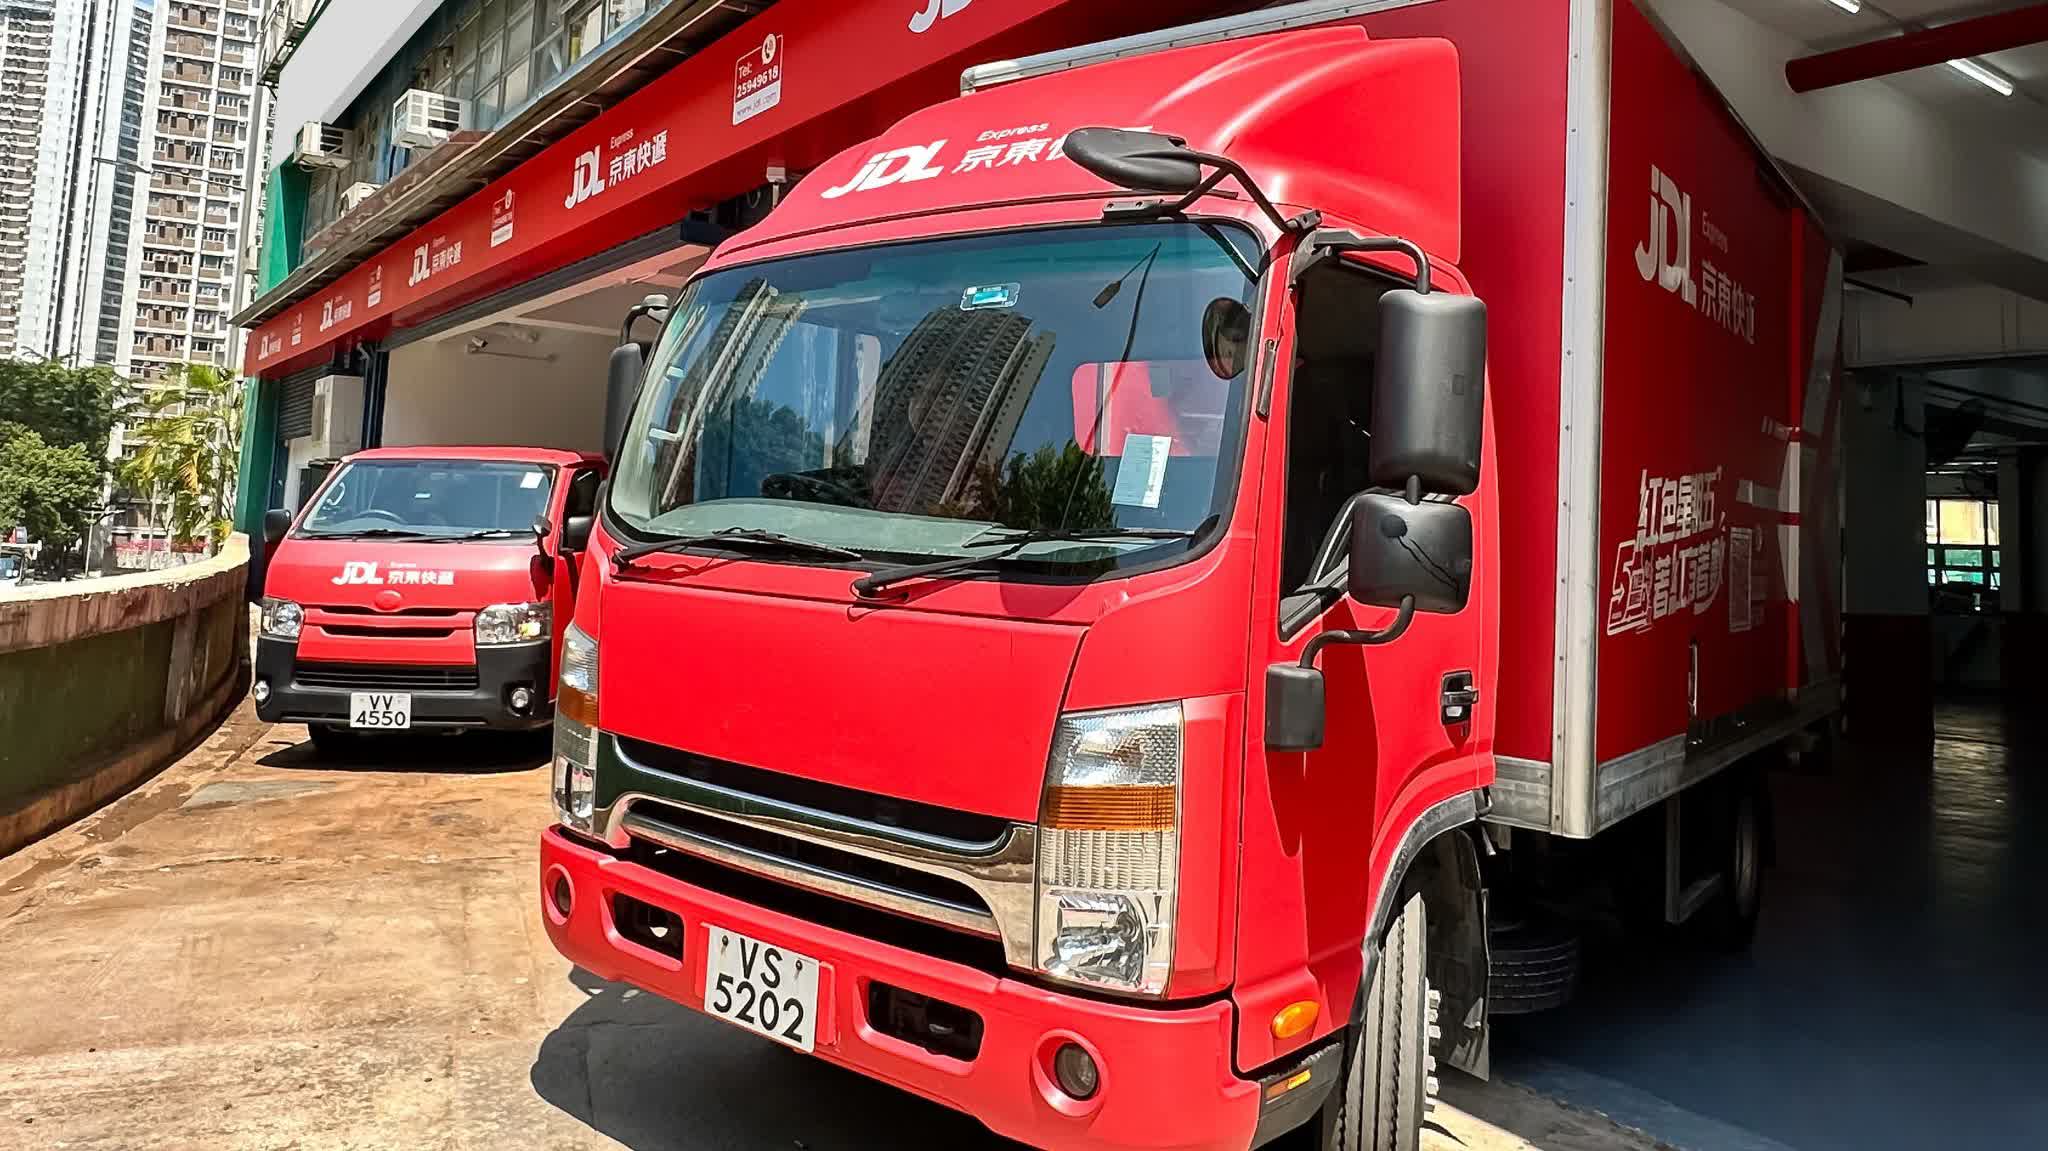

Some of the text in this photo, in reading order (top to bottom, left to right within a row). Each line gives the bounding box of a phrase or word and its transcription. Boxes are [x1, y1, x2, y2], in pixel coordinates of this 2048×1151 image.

[976, 123, 1049, 142] Express
[564, 144, 605, 209] JDL
[821, 140, 949, 199] JDL
[1634, 164, 1697, 310] JDL
[408, 243, 430, 287] JDL
[331, 560, 384, 586] JDL
[355, 710, 406, 726] 4550
[369, 695, 393, 710] VV
[740, 937, 783, 989] VS
[713, 972, 804, 1044] 5202
